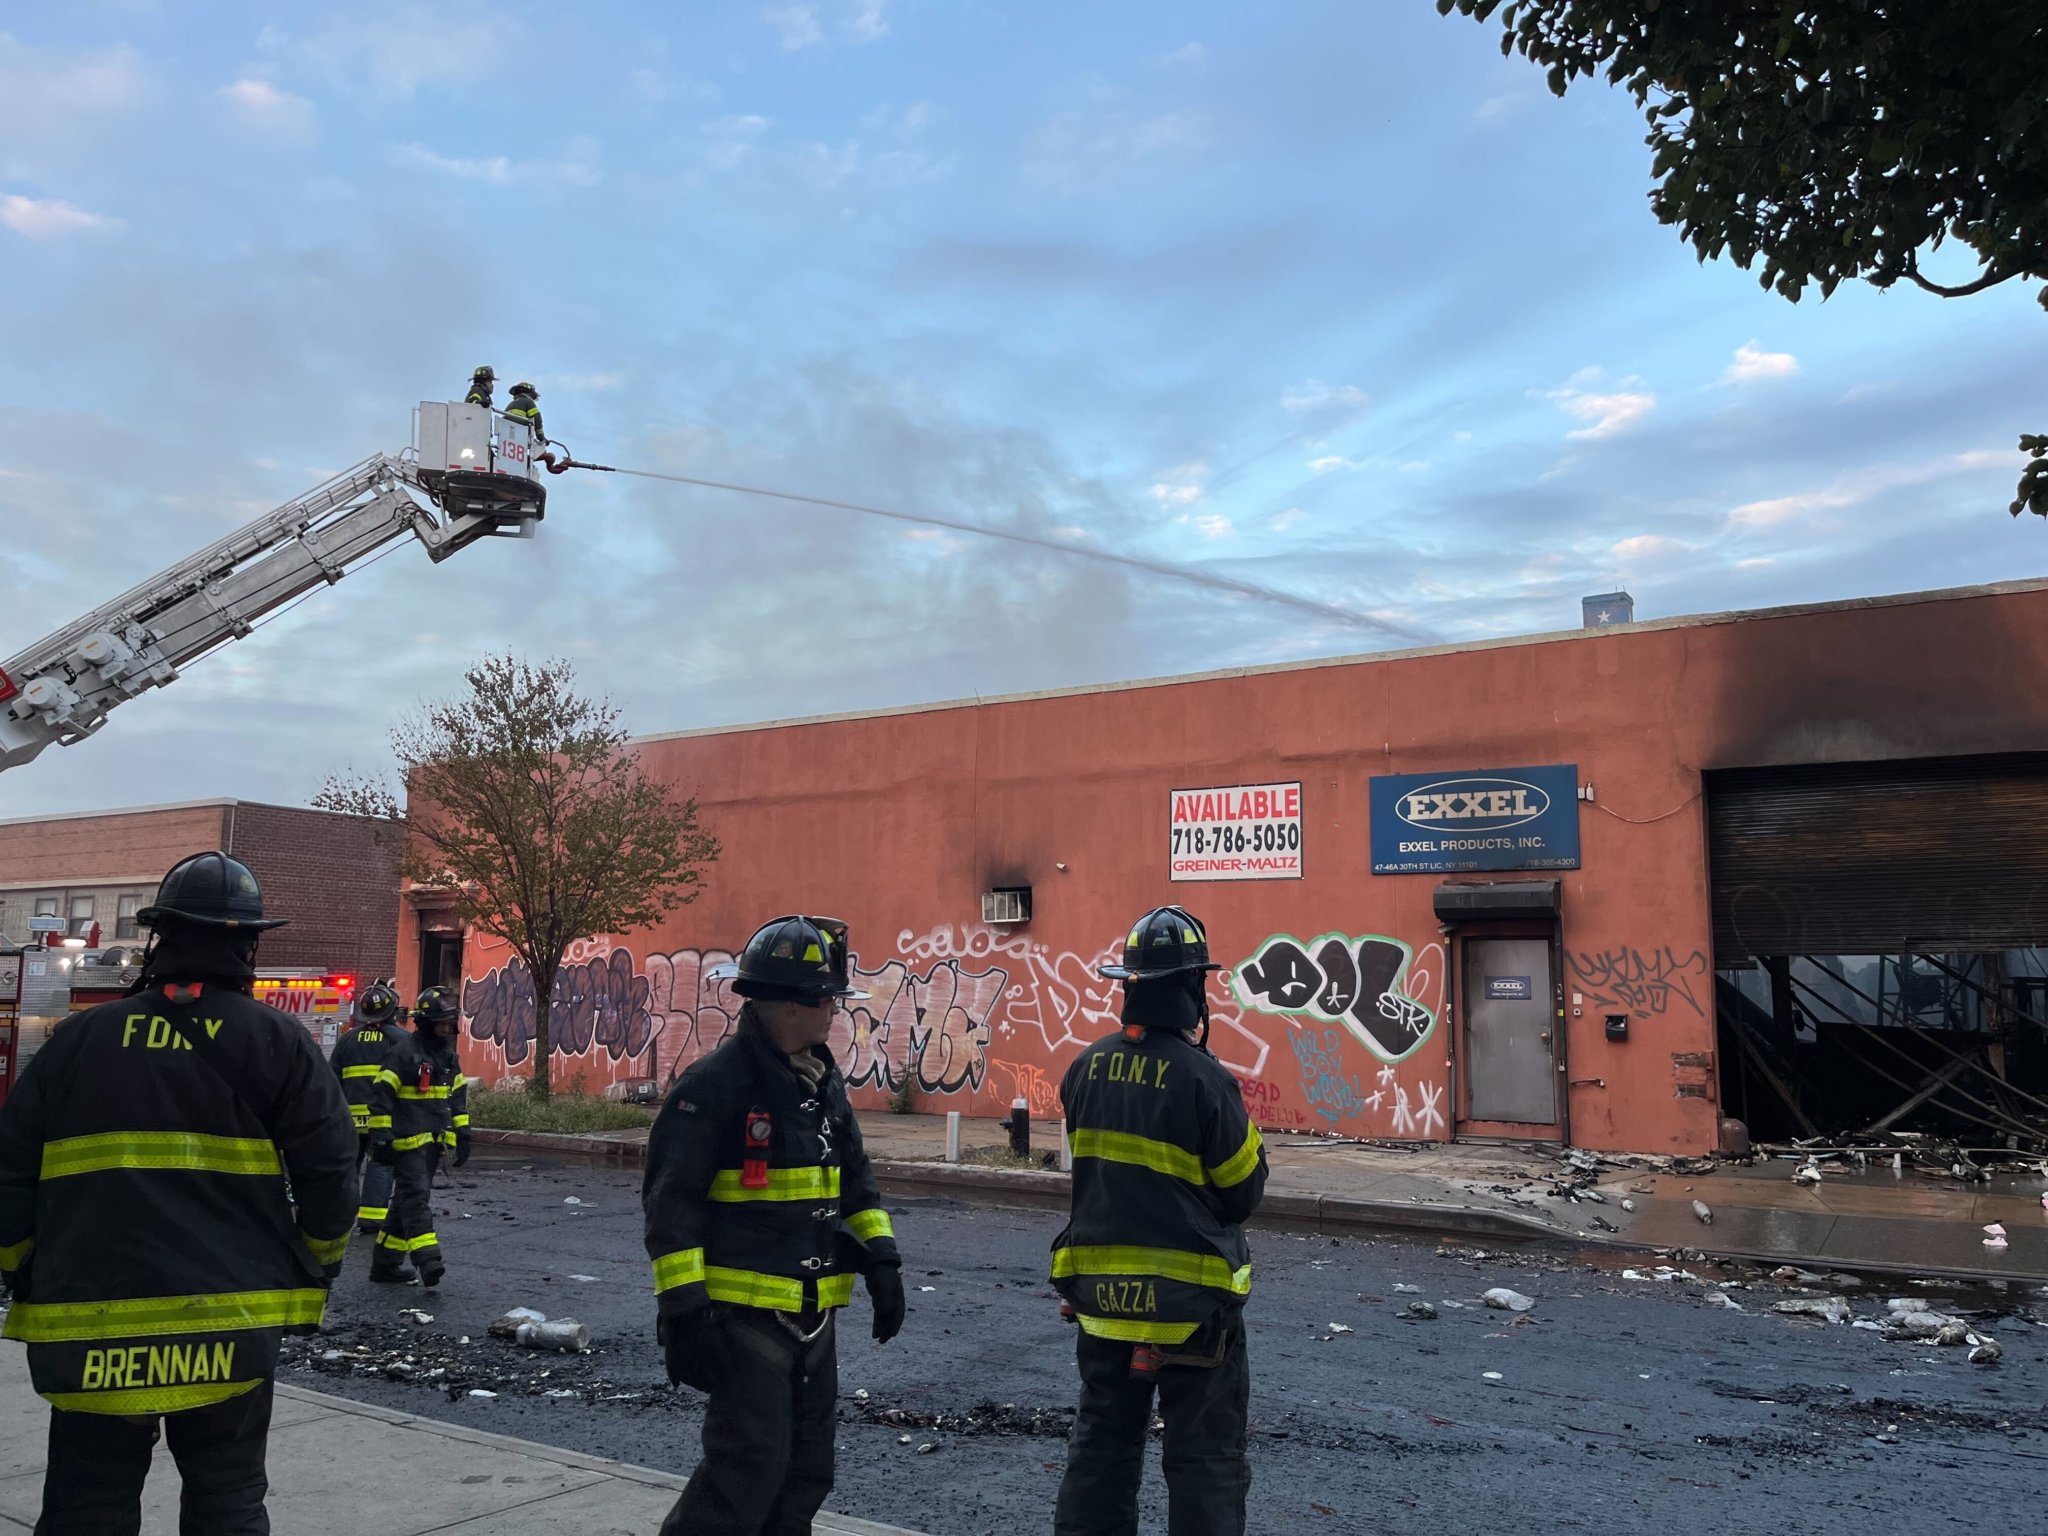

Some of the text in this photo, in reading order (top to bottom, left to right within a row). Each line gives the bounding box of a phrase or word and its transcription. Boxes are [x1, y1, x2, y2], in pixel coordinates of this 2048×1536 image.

[501, 440, 525, 462] 138
[1173, 788, 1299, 823] AVAILABLE
[1407, 790, 1537, 820] EXXEL
[1173, 822, 1299, 854] 718-786-5050
[1399, 836, 1546, 852] EXXEL PRODUCTS, INC.
[1172, 856, 1298, 872] GREINER-MALTZ
[1399, 862, 1418, 870] 30TH
[1420, 862, 1429, 870] ST
[1445, 861, 1456, 869] NY
[264, 992, 315, 1014] FDNY
[1096, 1280, 1156, 1312] GAZZA
[82, 1341, 236, 1389] BRENNAN
